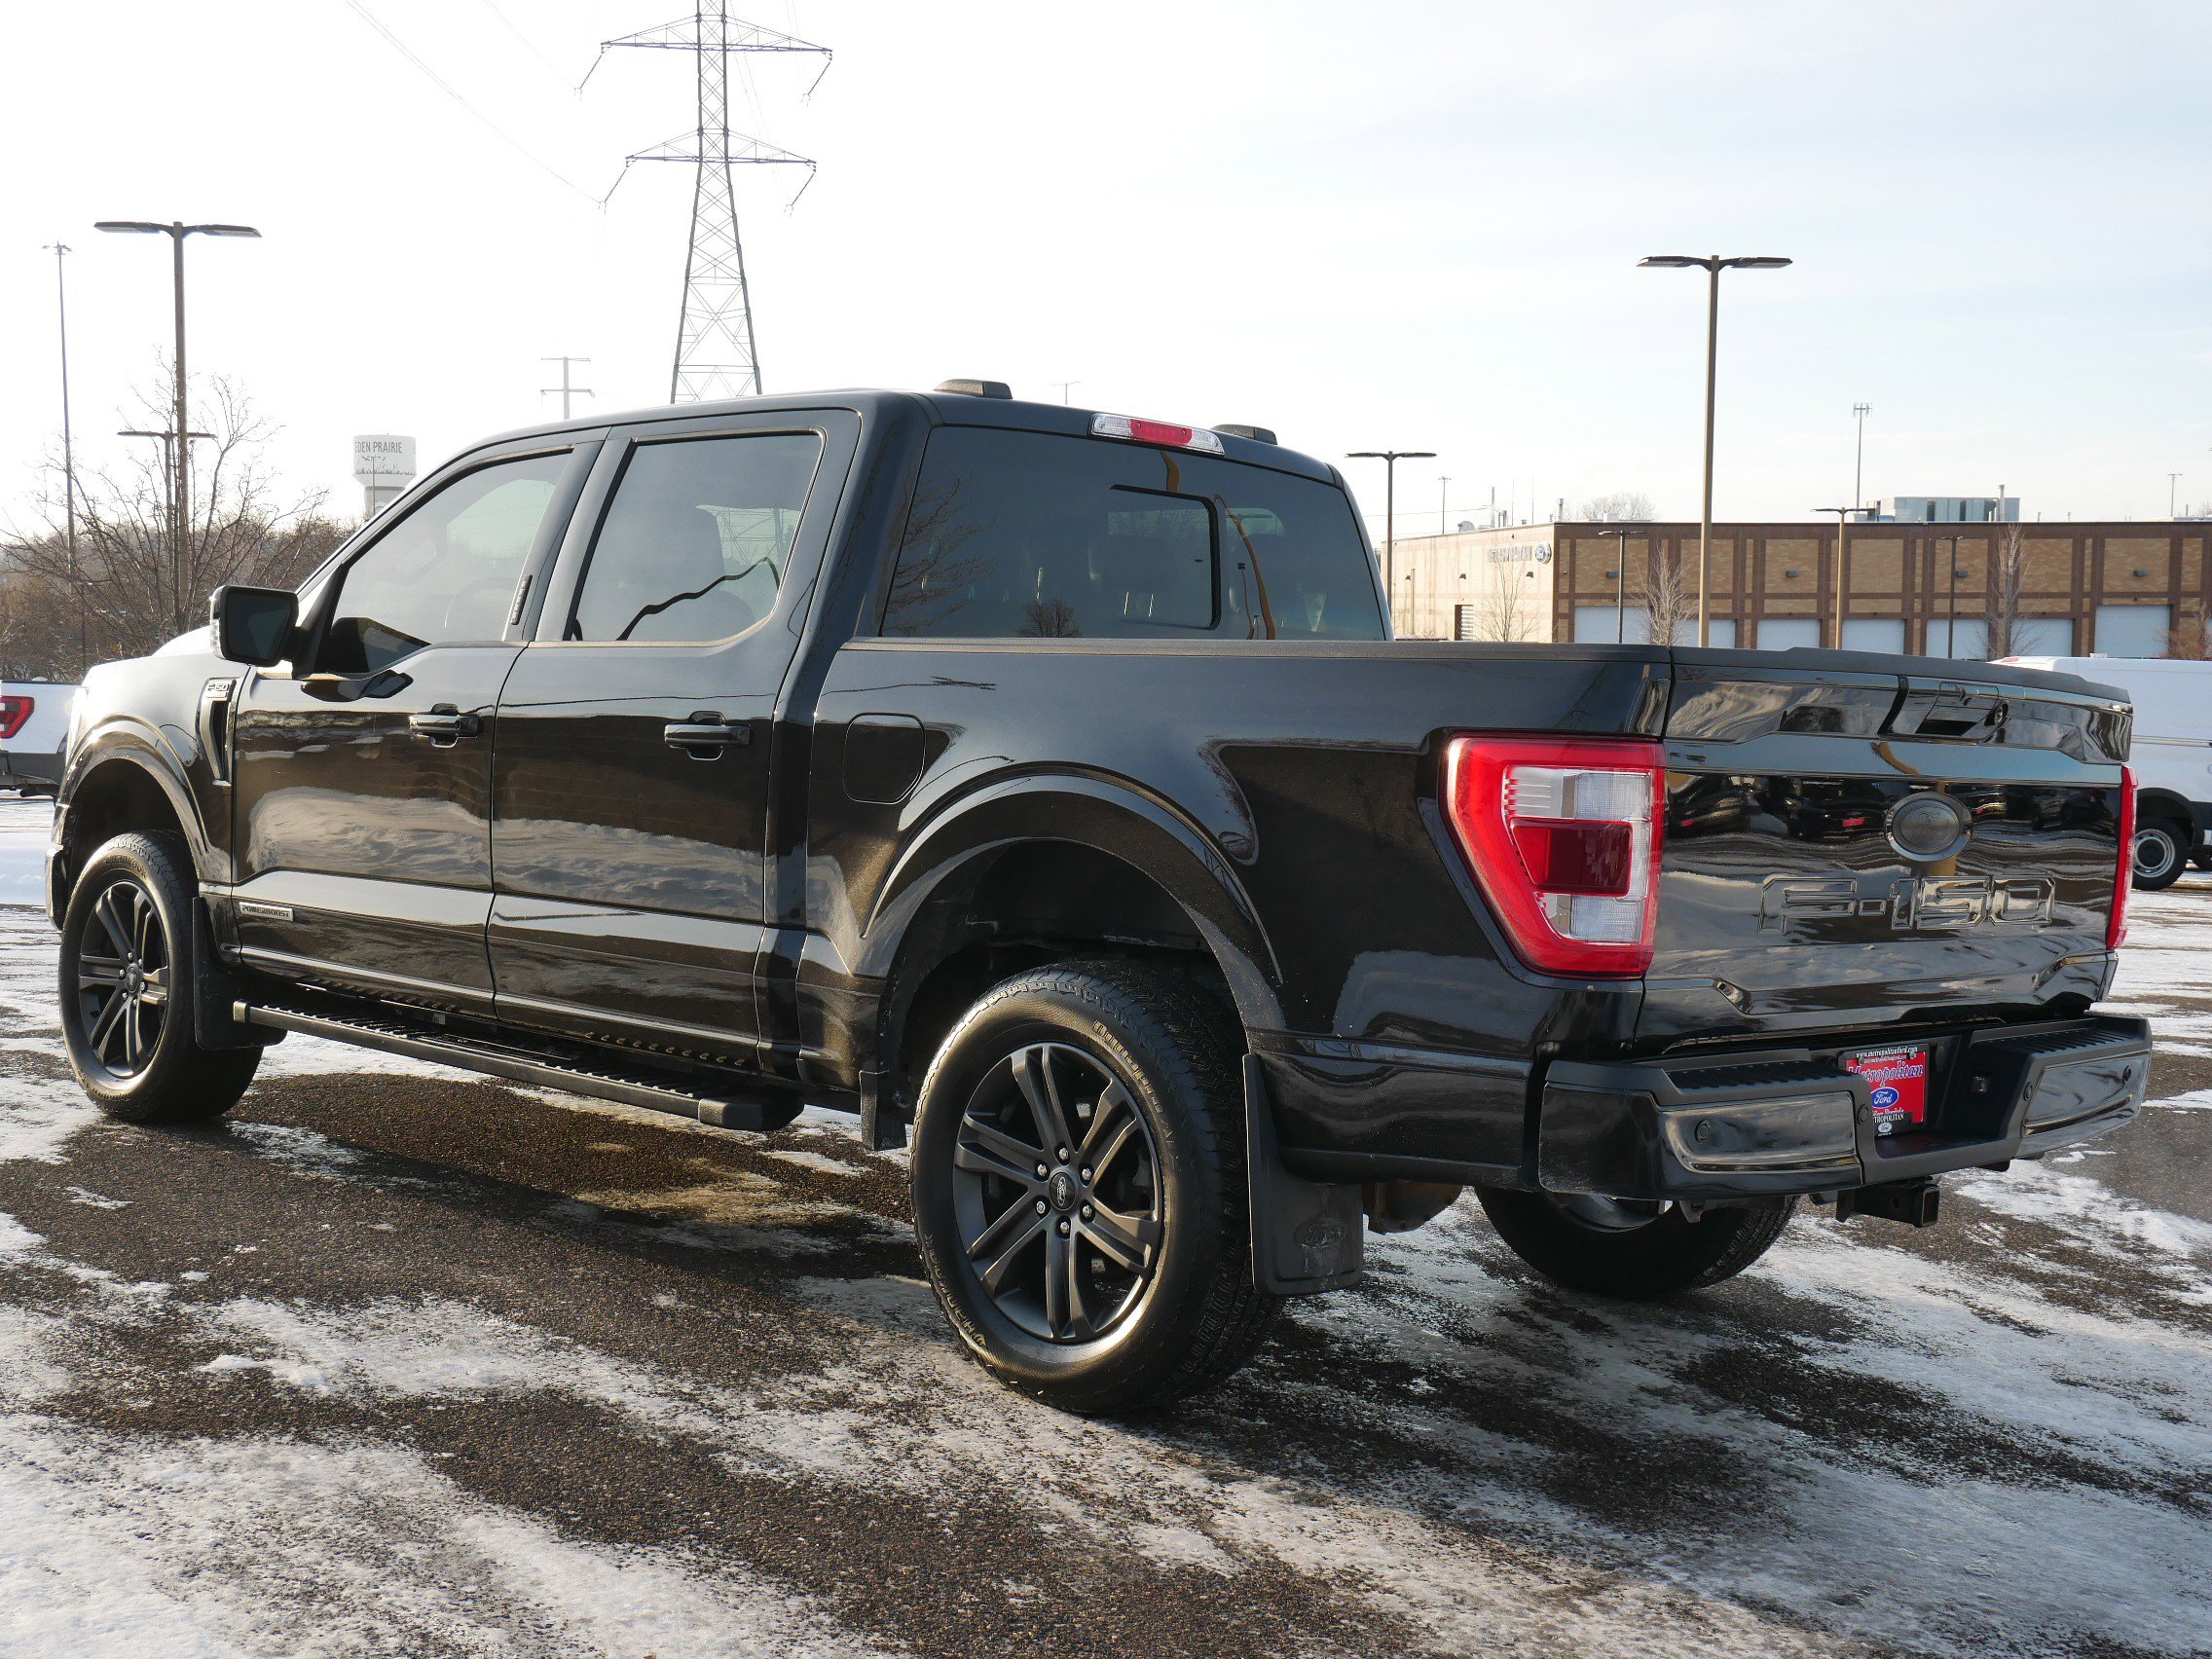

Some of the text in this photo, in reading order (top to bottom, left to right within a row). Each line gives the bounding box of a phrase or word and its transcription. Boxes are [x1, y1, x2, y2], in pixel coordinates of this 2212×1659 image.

[354, 441, 402, 453] EDEN PRAIRIE
[1757, 875, 2055, 935] F-150
[1873, 1090, 1893, 1105] Ford
[1873, 1113, 1904, 1124] TROPOLITAN
